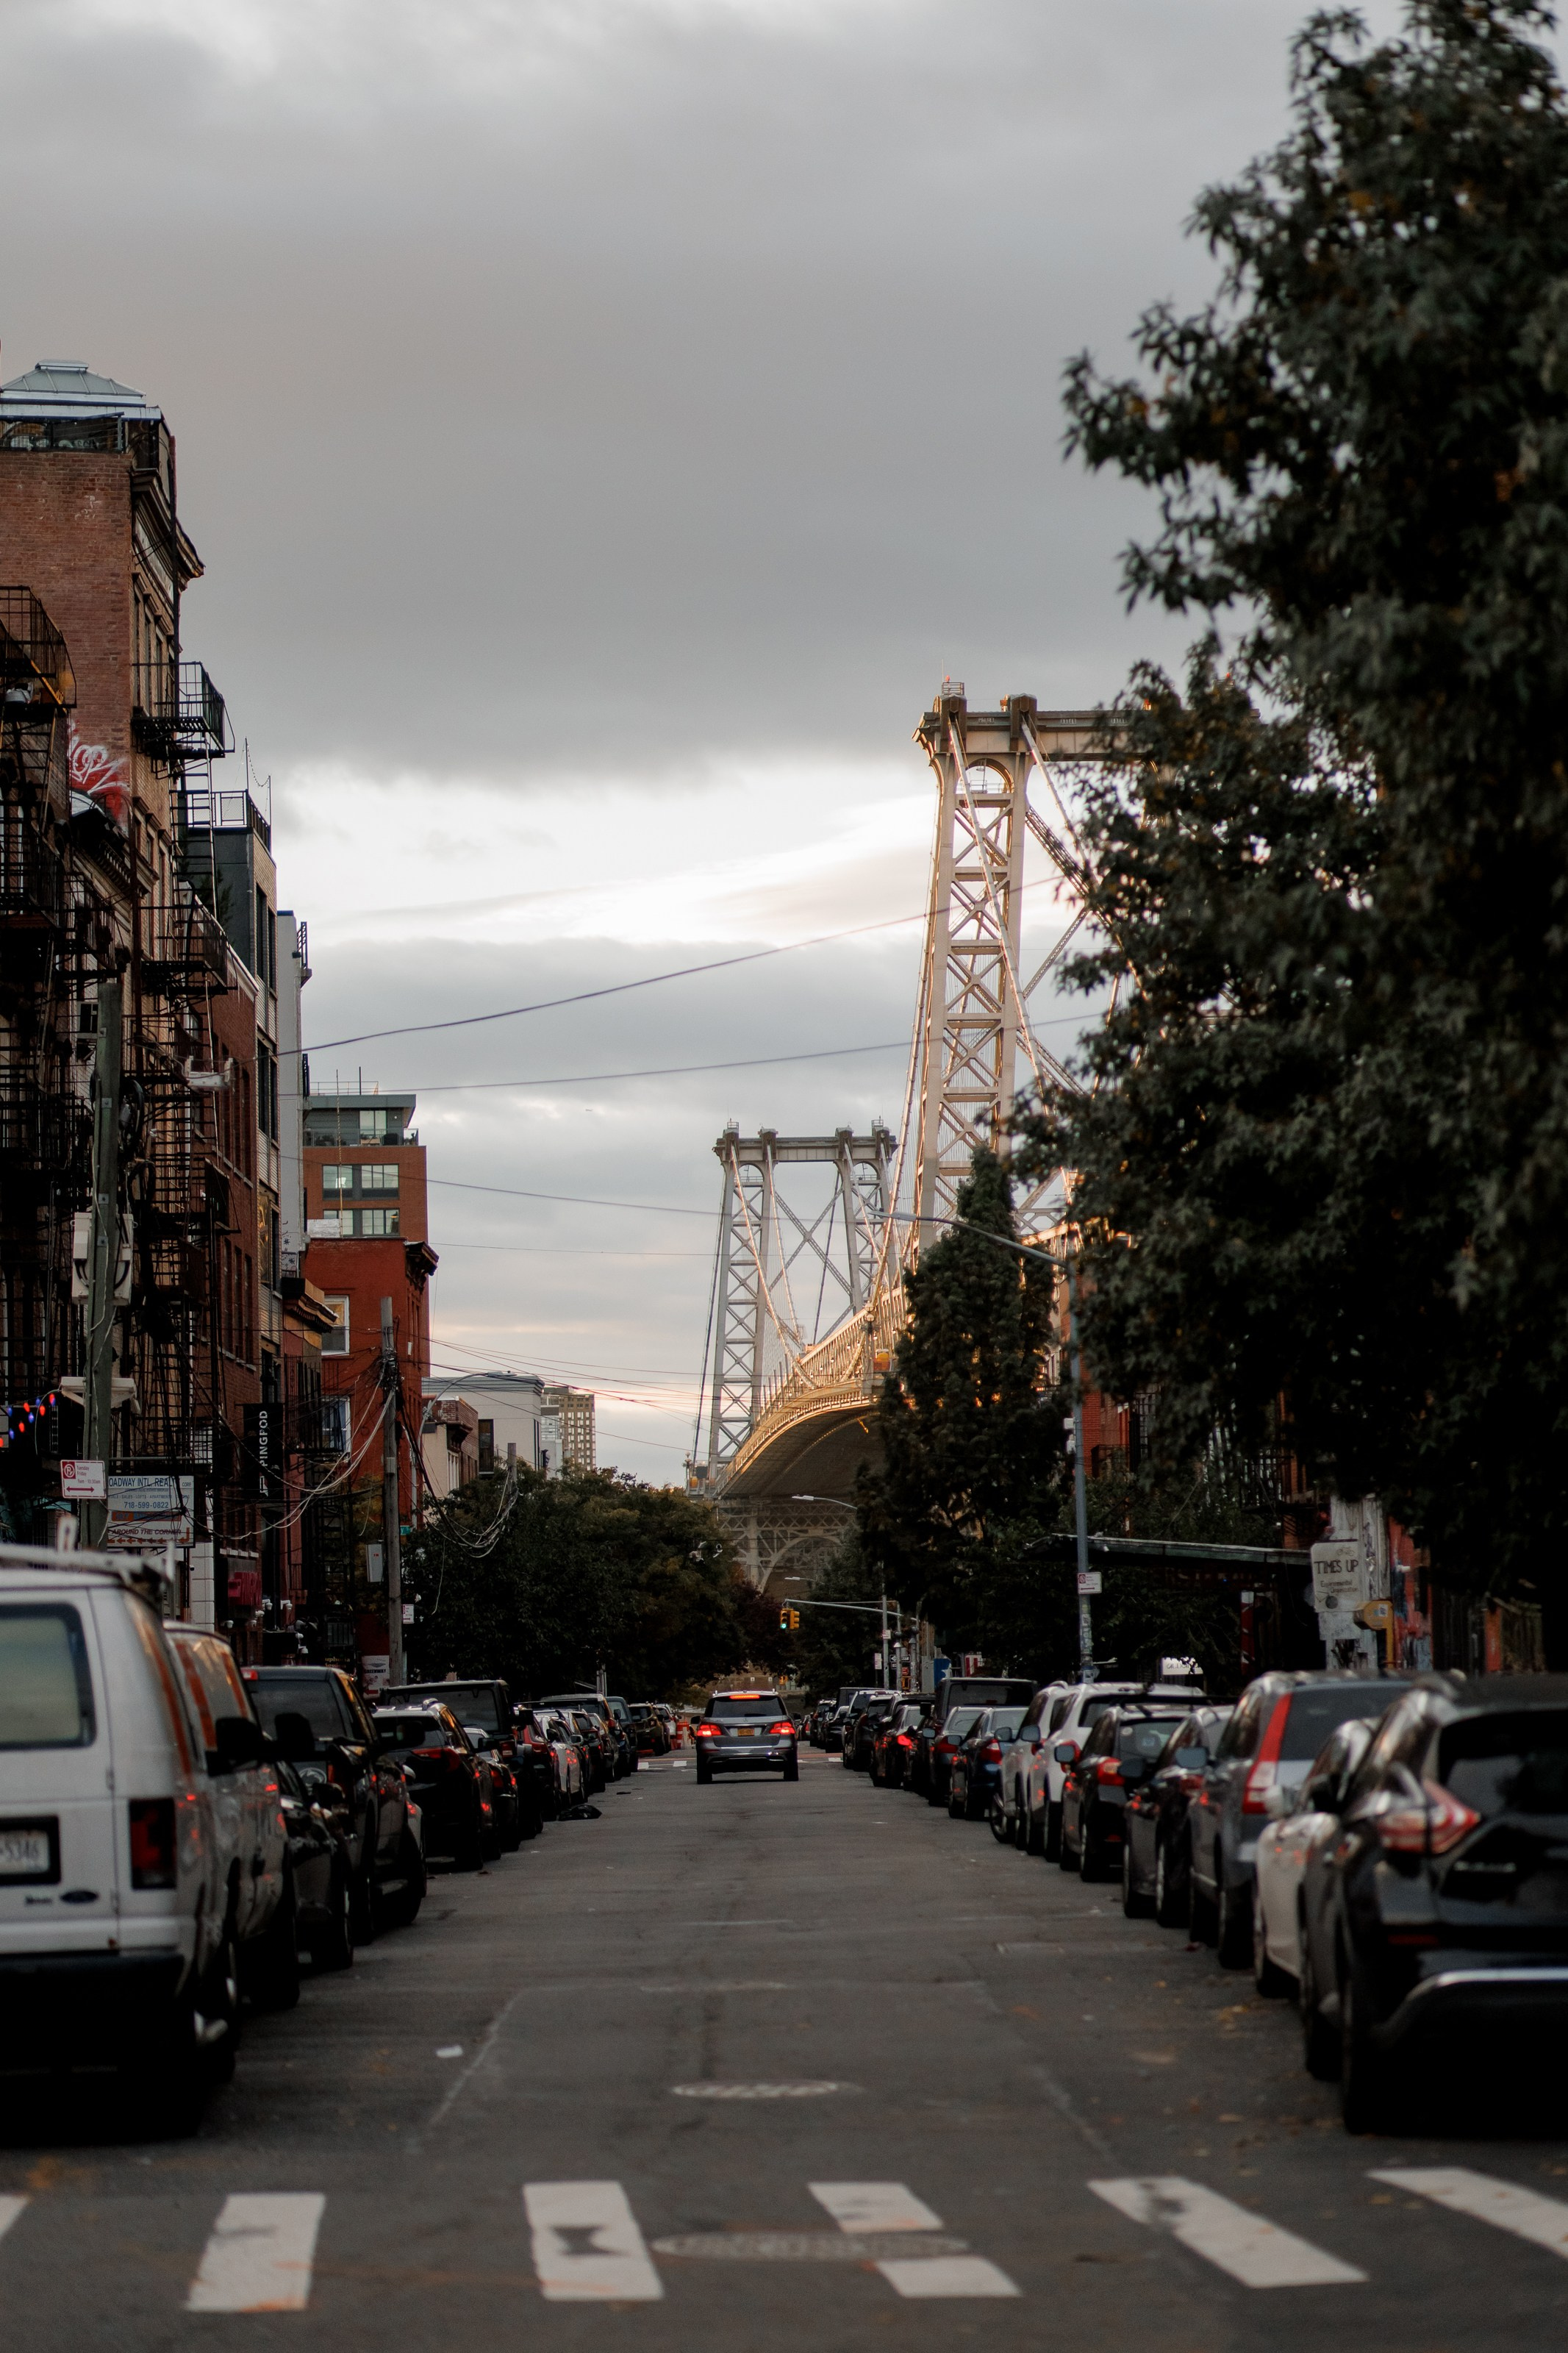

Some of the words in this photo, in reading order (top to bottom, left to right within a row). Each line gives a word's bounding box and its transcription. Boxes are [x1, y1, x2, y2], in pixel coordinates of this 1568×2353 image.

[259, 1410, 268, 1467] PINGPOD
[109, 1477, 135, 1487] OADWAY
[154, 1477, 179, 1487] REAL
[1345, 1559, 1358, 1573] UP
